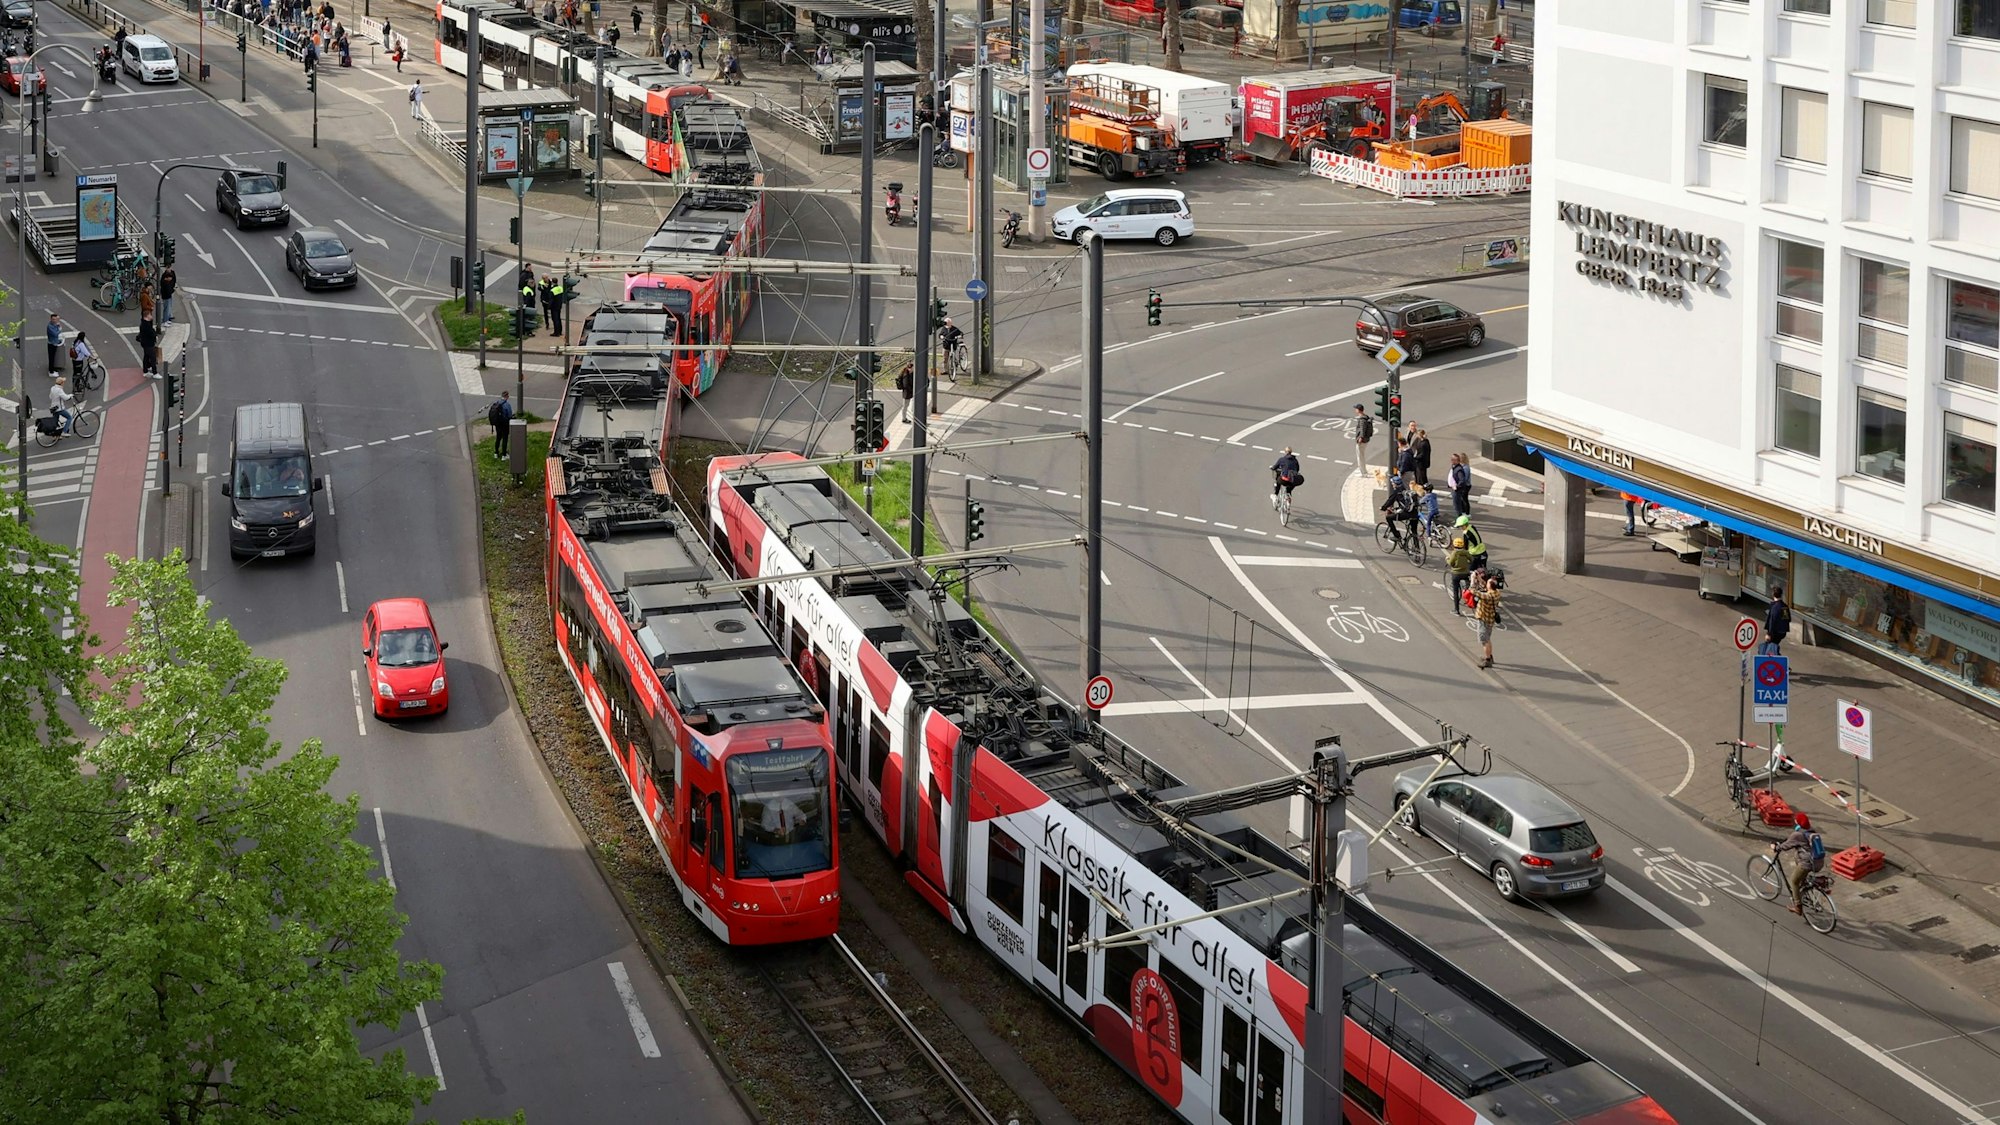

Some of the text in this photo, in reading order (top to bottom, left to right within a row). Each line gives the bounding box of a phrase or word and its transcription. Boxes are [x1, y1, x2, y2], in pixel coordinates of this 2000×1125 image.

[872, 26, 891, 37] Ali's
[523, 111, 532, 120] U
[842, 106, 863, 114] Freud
[79, 177, 86, 185] U
[88, 176, 116, 184] Neumarkt
[1557, 199, 1722, 261] KUNSTHAUS
[1575, 231, 1722, 290] LEMPERTZ
[1575, 259, 1634, 289] GEGR.
[1566, 435, 1634, 471] TASCHEN
[1802, 514, 1884, 556] TASCHEN
[577, 553, 606, 620] Feuerwehr
[606, 604, 622, 646] Köln
[807, 592, 823, 631] für
[826, 623, 854, 667] alle!
[1739, 626, 1753, 643] 30
[1928, 608, 1968, 632] WALTON
[1970, 627, 1998, 643] FORD
[1091, 685, 1108, 702] 30
[764, 755, 804, 765] Testfahrt
[1044, 815, 1255, 1005] Klassik für alle!
[987, 911, 1025, 948] GÜRZENICH
[987, 920, 1025, 956] ORCHESTER
[997, 934, 1015, 956] KÖLN
[1135, 976, 1148, 1013] JAHRE
